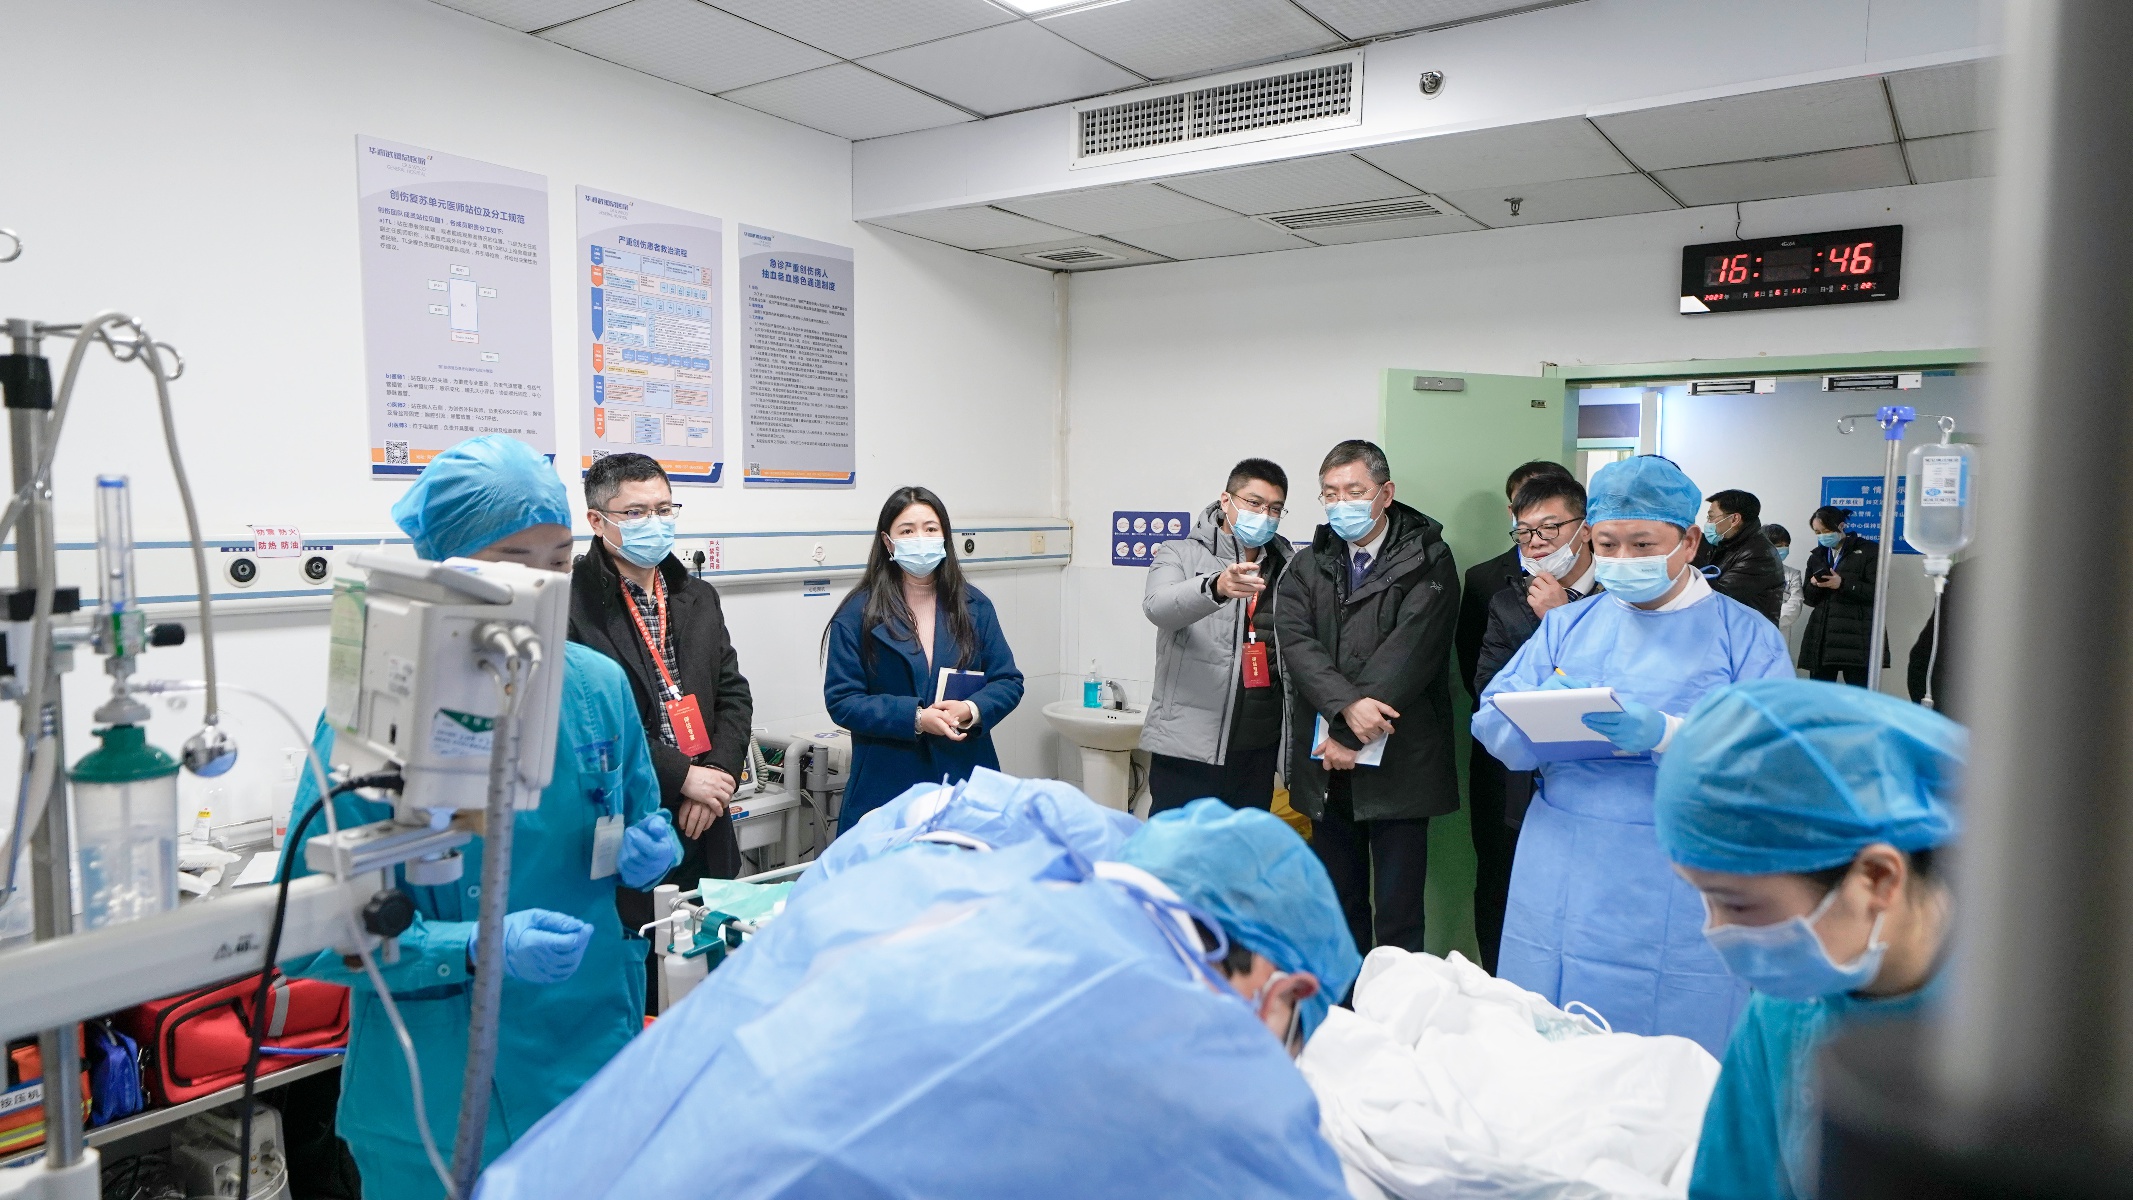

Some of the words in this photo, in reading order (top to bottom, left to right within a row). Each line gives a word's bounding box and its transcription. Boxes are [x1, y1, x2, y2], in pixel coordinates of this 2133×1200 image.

[390, 189, 526, 224] 创伤复苏单元医师站位及分工规范
[618, 235, 687, 258] 严重创伤患者救治流程
[769, 258, 828, 278] 急诊严重创伤病人
[762, 268, 836, 291] 抽血备血绿色通道制度
[1861, 486, 1906, 494] 警情示
[256, 528, 274, 536] 防震
[278, 528, 298, 536] 防火
[258, 541, 277, 550] 防热
[280, 541, 298, 550] 防油
